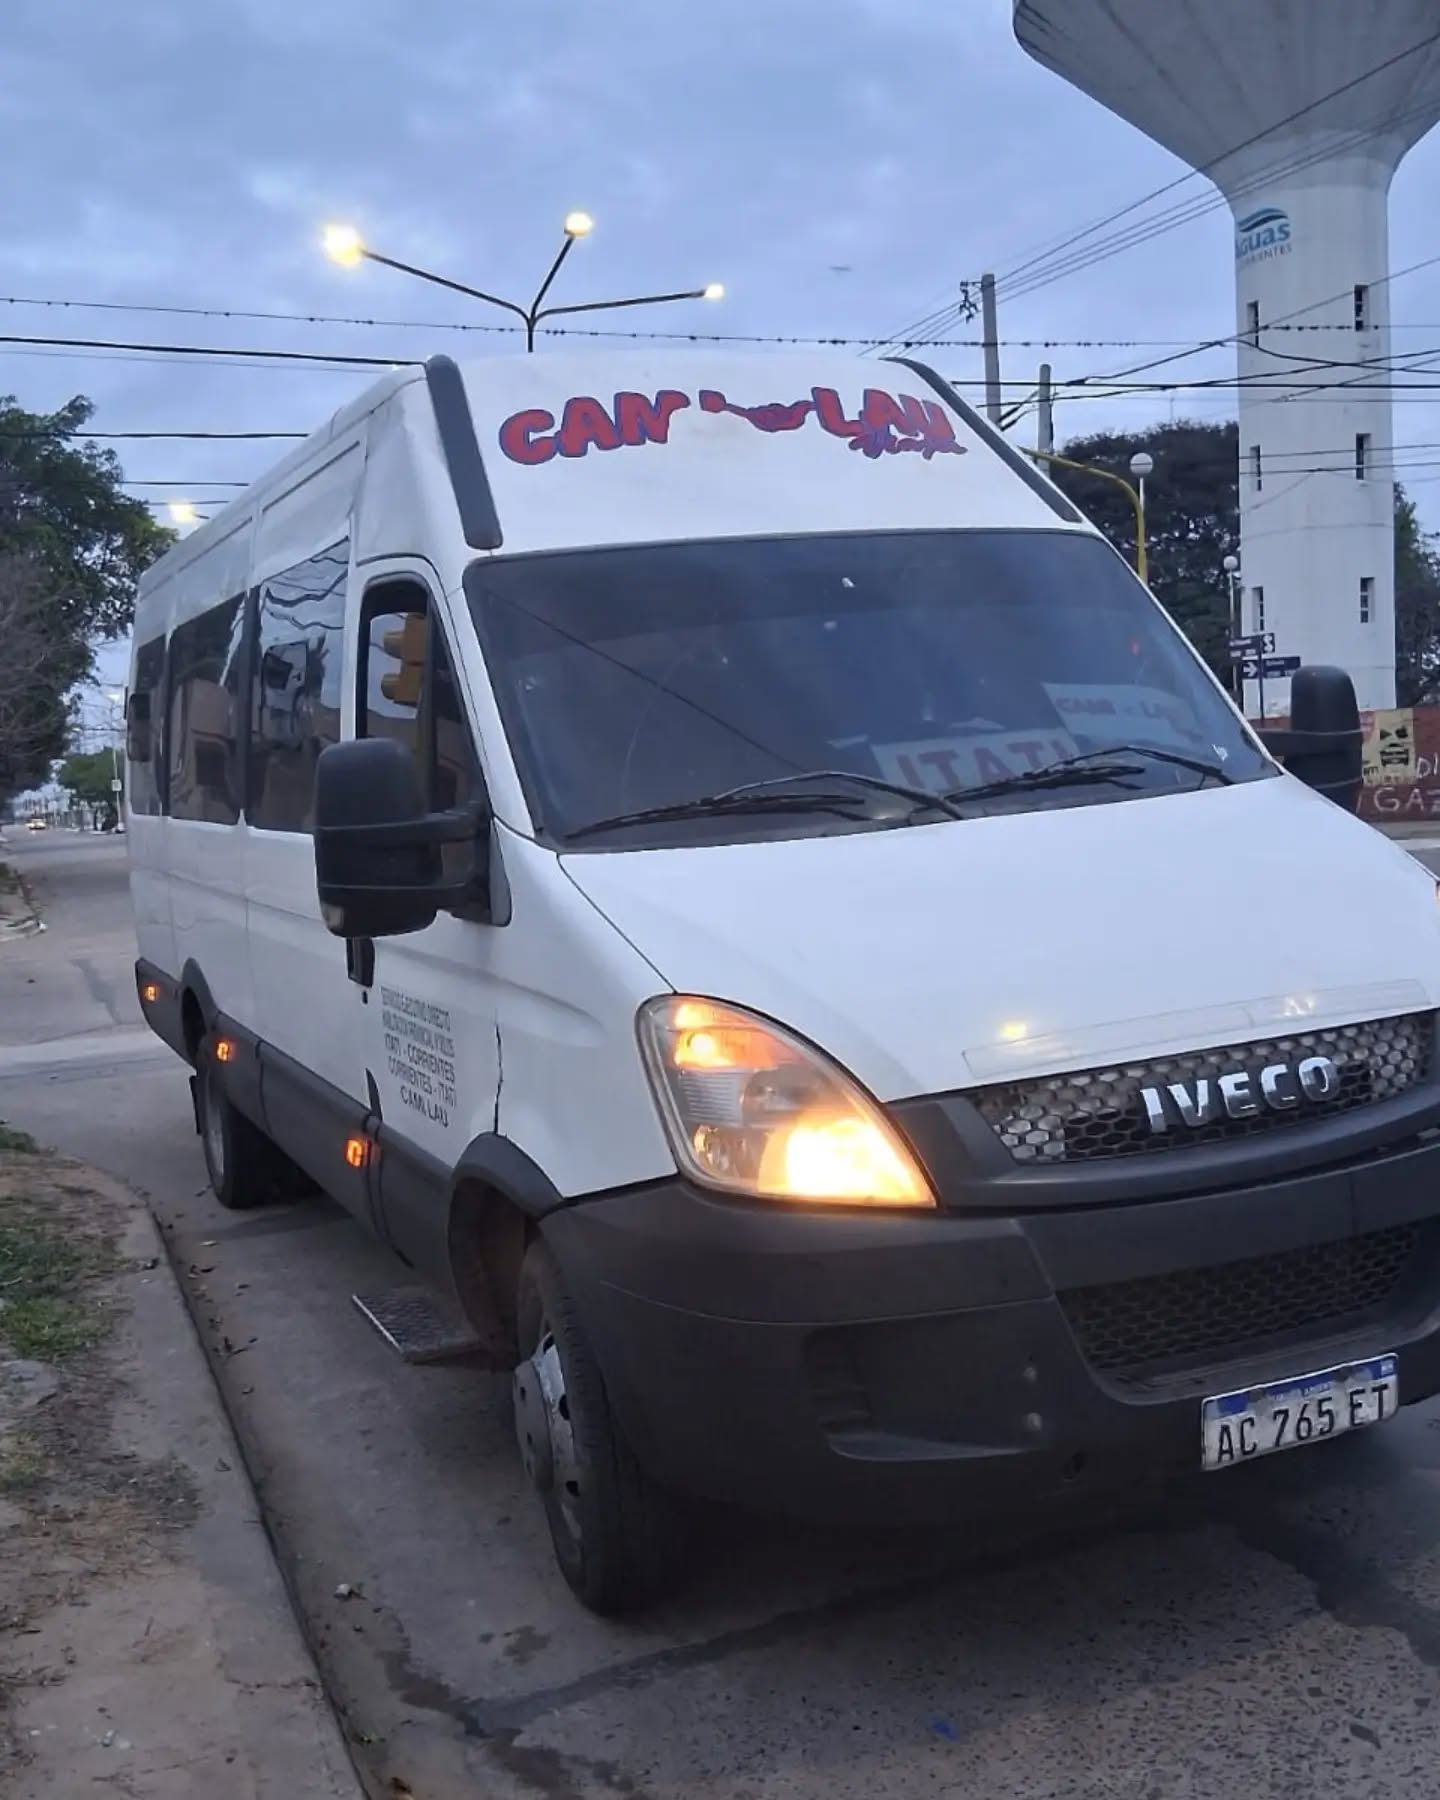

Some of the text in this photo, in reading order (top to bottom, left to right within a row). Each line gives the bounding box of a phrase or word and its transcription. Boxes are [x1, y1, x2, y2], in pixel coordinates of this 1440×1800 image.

[1140, 1056, 1342, 1134] IVECO
[1217, 1416, 1258, 1463] AC
[1272, 1396, 1335, 1448] 765
[1350, 1383, 1389, 1427] ET
